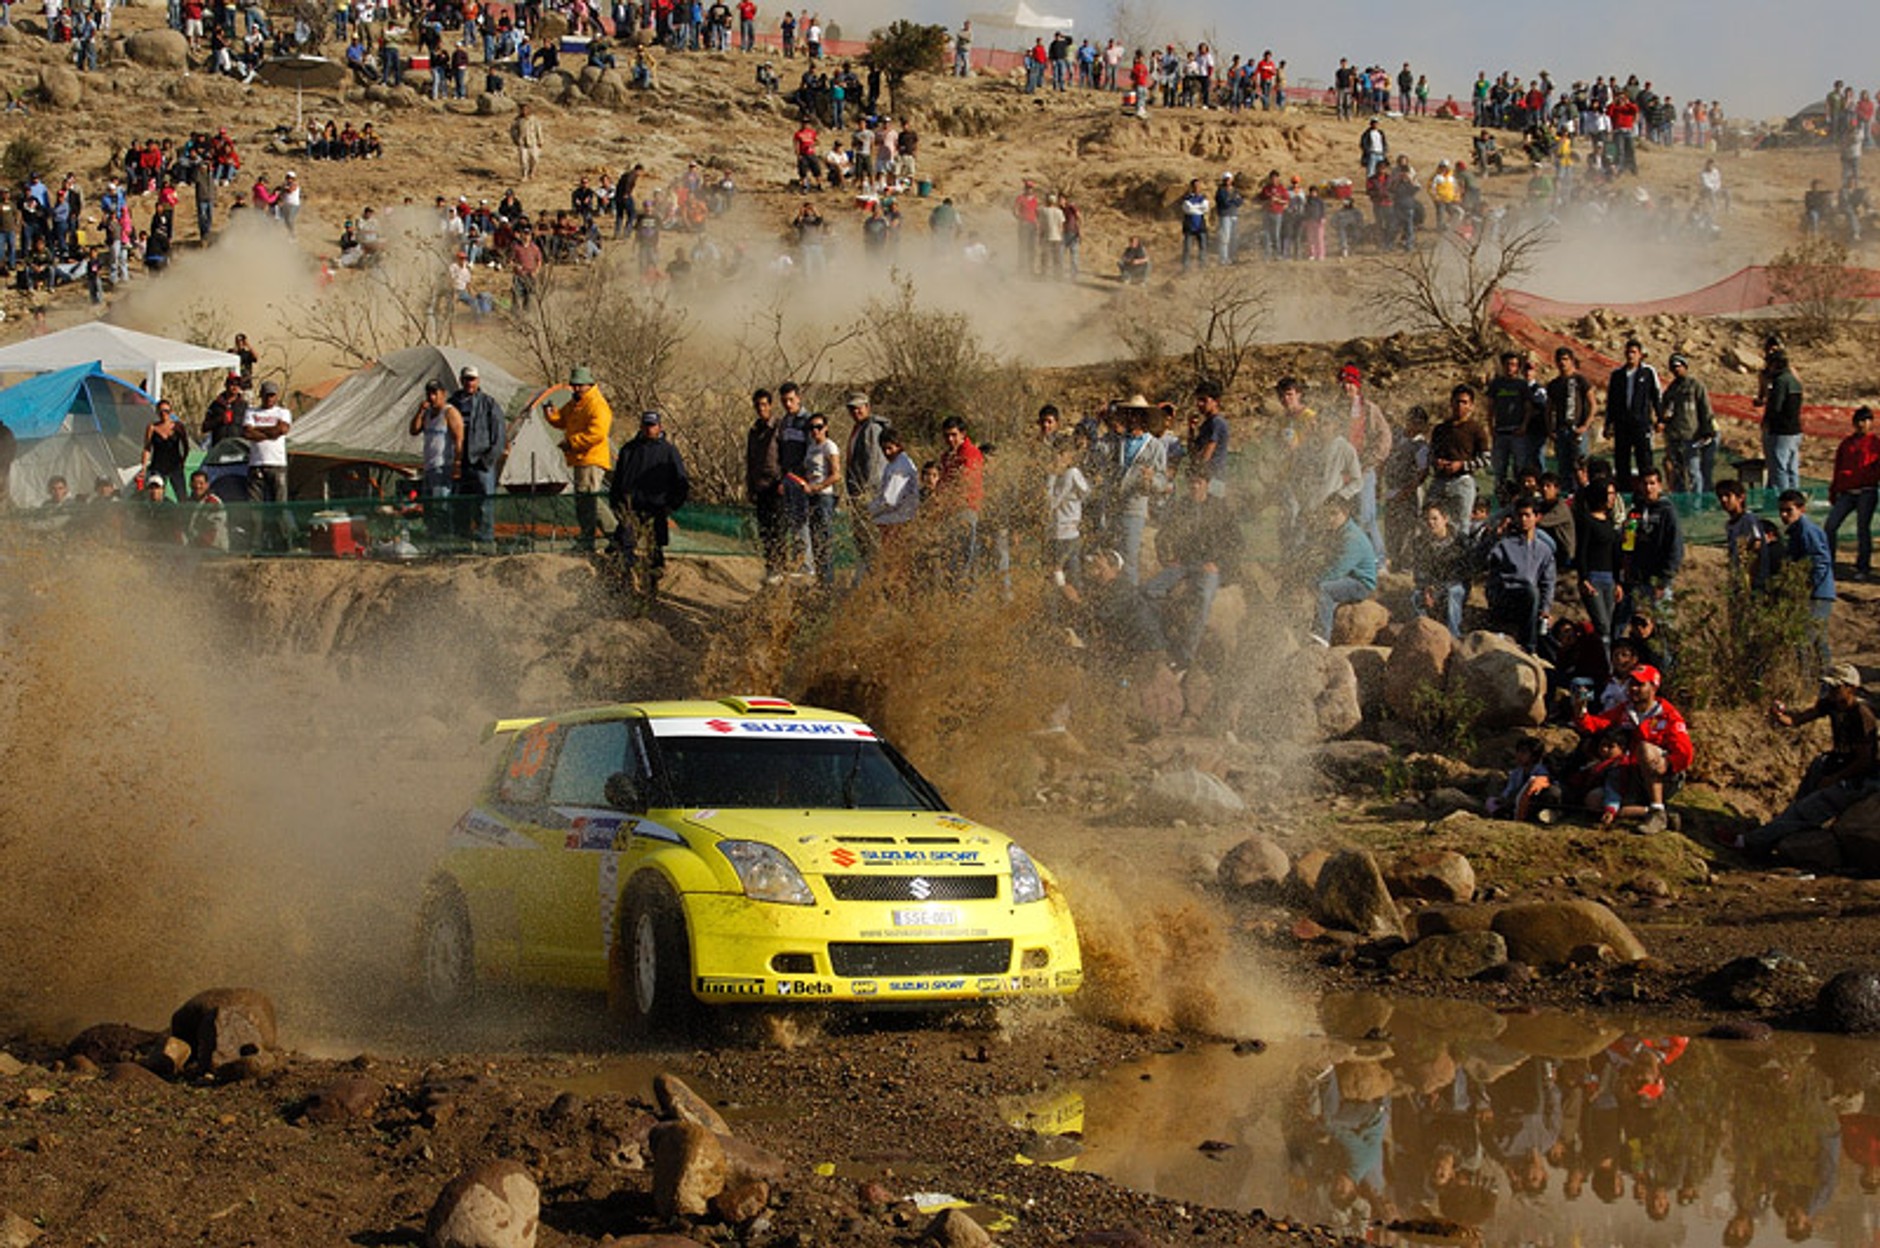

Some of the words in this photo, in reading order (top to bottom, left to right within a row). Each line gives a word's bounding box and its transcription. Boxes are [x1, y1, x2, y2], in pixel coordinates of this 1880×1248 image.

[741, 723, 845, 734] SUZUKI
[860, 851, 926, 860] SUZUKI
[930, 851, 979, 861] SPORT
[697, 977, 765, 994] PIRELLI
[793, 980, 833, 994] Beta
[889, 982, 929, 990] SUZUKI
[931, 980, 965, 989] SPORT
